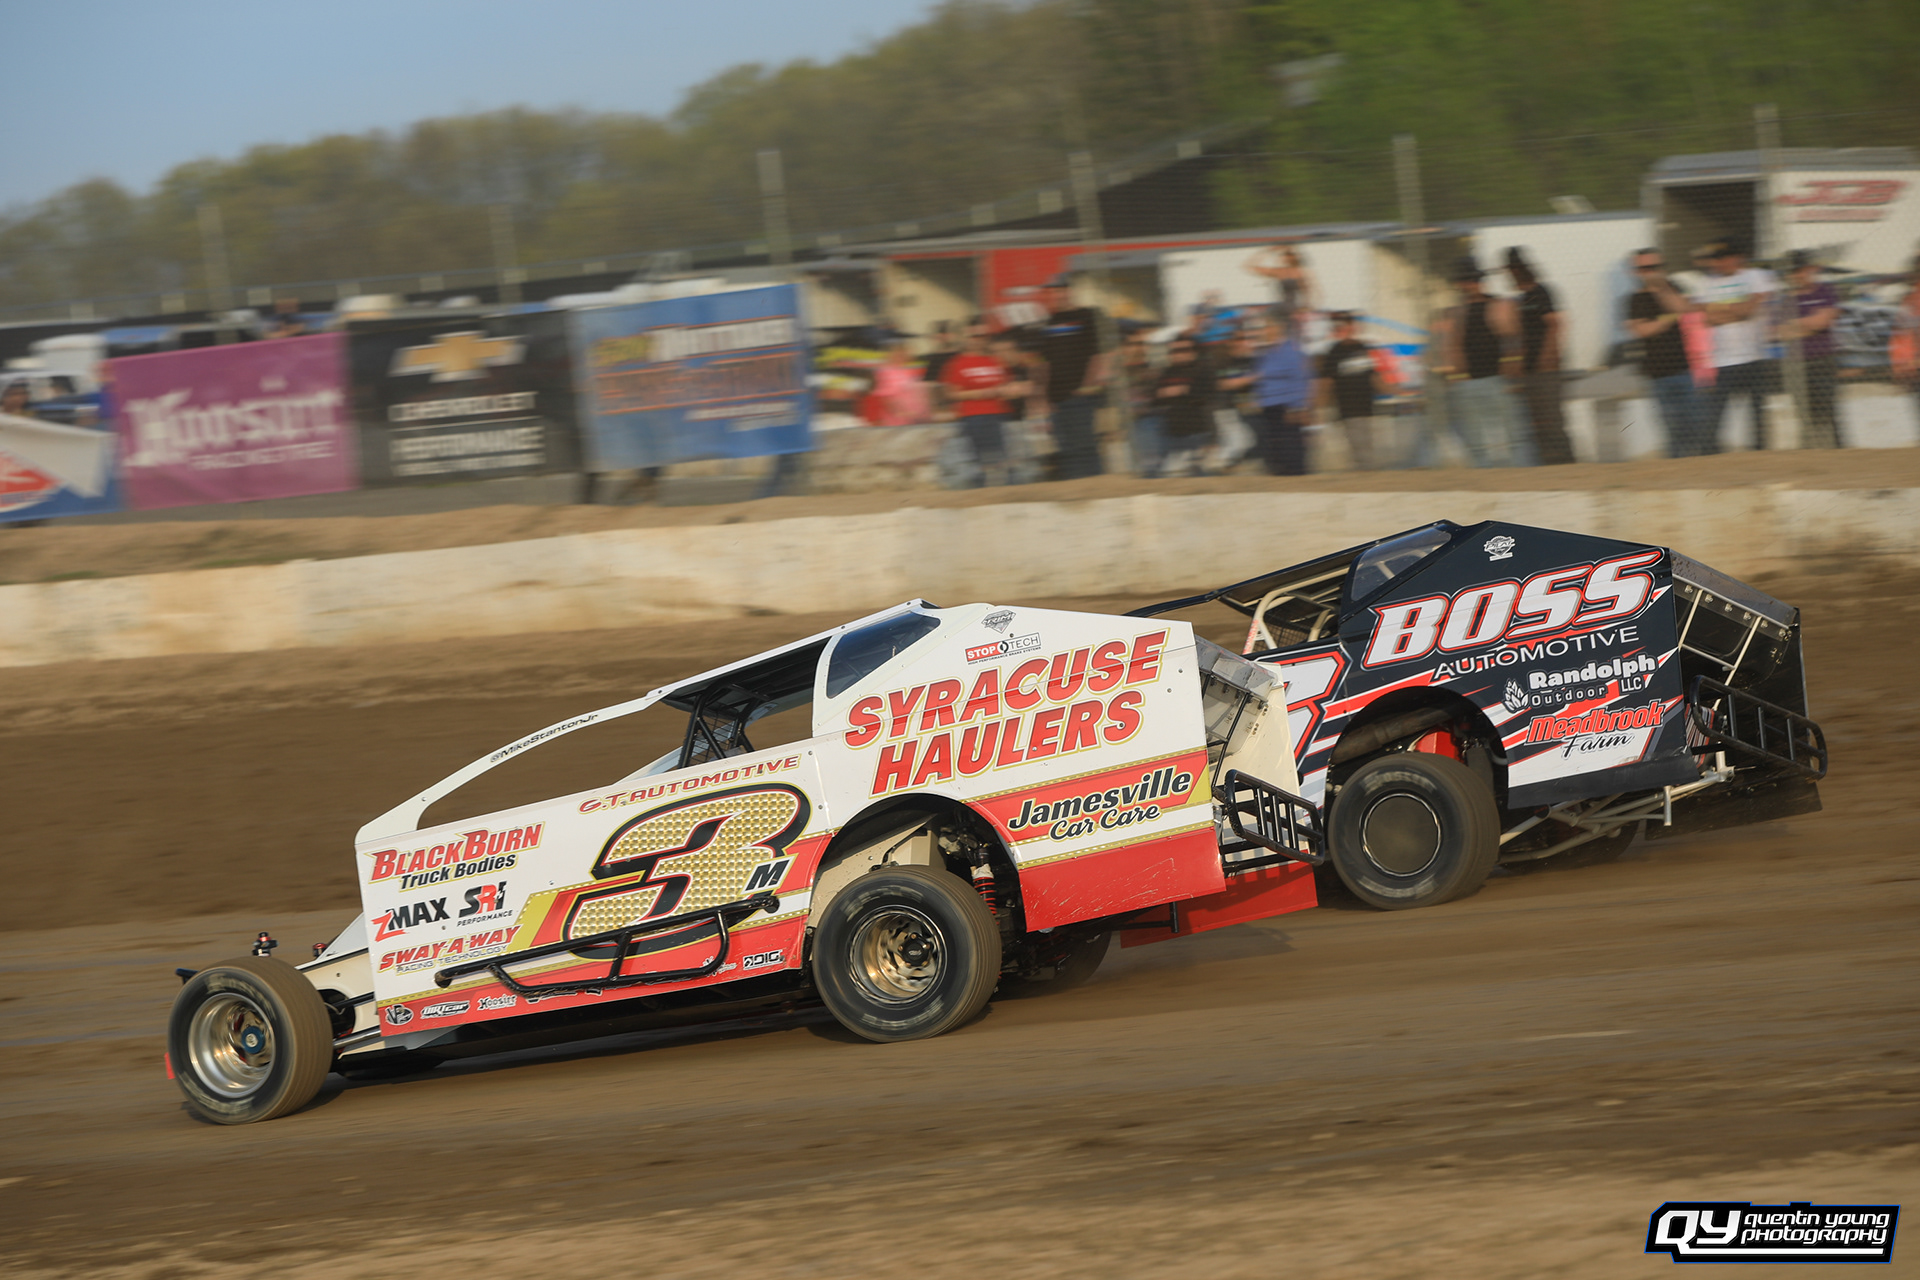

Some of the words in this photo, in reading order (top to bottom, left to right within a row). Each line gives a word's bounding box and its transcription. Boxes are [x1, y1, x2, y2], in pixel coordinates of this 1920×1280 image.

[1363, 551, 1662, 668] BOSS
[1434, 626, 1639, 679] AUTOMOTIVE
[1529, 654, 1656, 690] Randolph
[845, 630, 1168, 748] SYRACUSE
[1531, 686, 1606, 706] Outdoor
[1621, 677, 1643, 692] LLC
[490, 714, 598, 763] @MikeStantonJr
[871, 690, 1143, 796] HAULERS
[1527, 701, 1664, 743] Meadbrook
[1564, 732, 1633, 758] Farm
[1008, 767, 1190, 829] Jamesville
[1049, 819, 1094, 840] Car
[1100, 805, 1160, 830] Care
[401, 867, 451, 889] Truck
[454, 854, 516, 879] Bodies
[562, 783, 811, 960] 3
[745, 860, 789, 892] M
[457, 910, 513, 928] PERFORMANCE
[379, 925, 521, 970] SWAY-A-WAY
[396, 960, 434, 974] RACING
[438, 945, 508, 965] TECHNOLOGY
